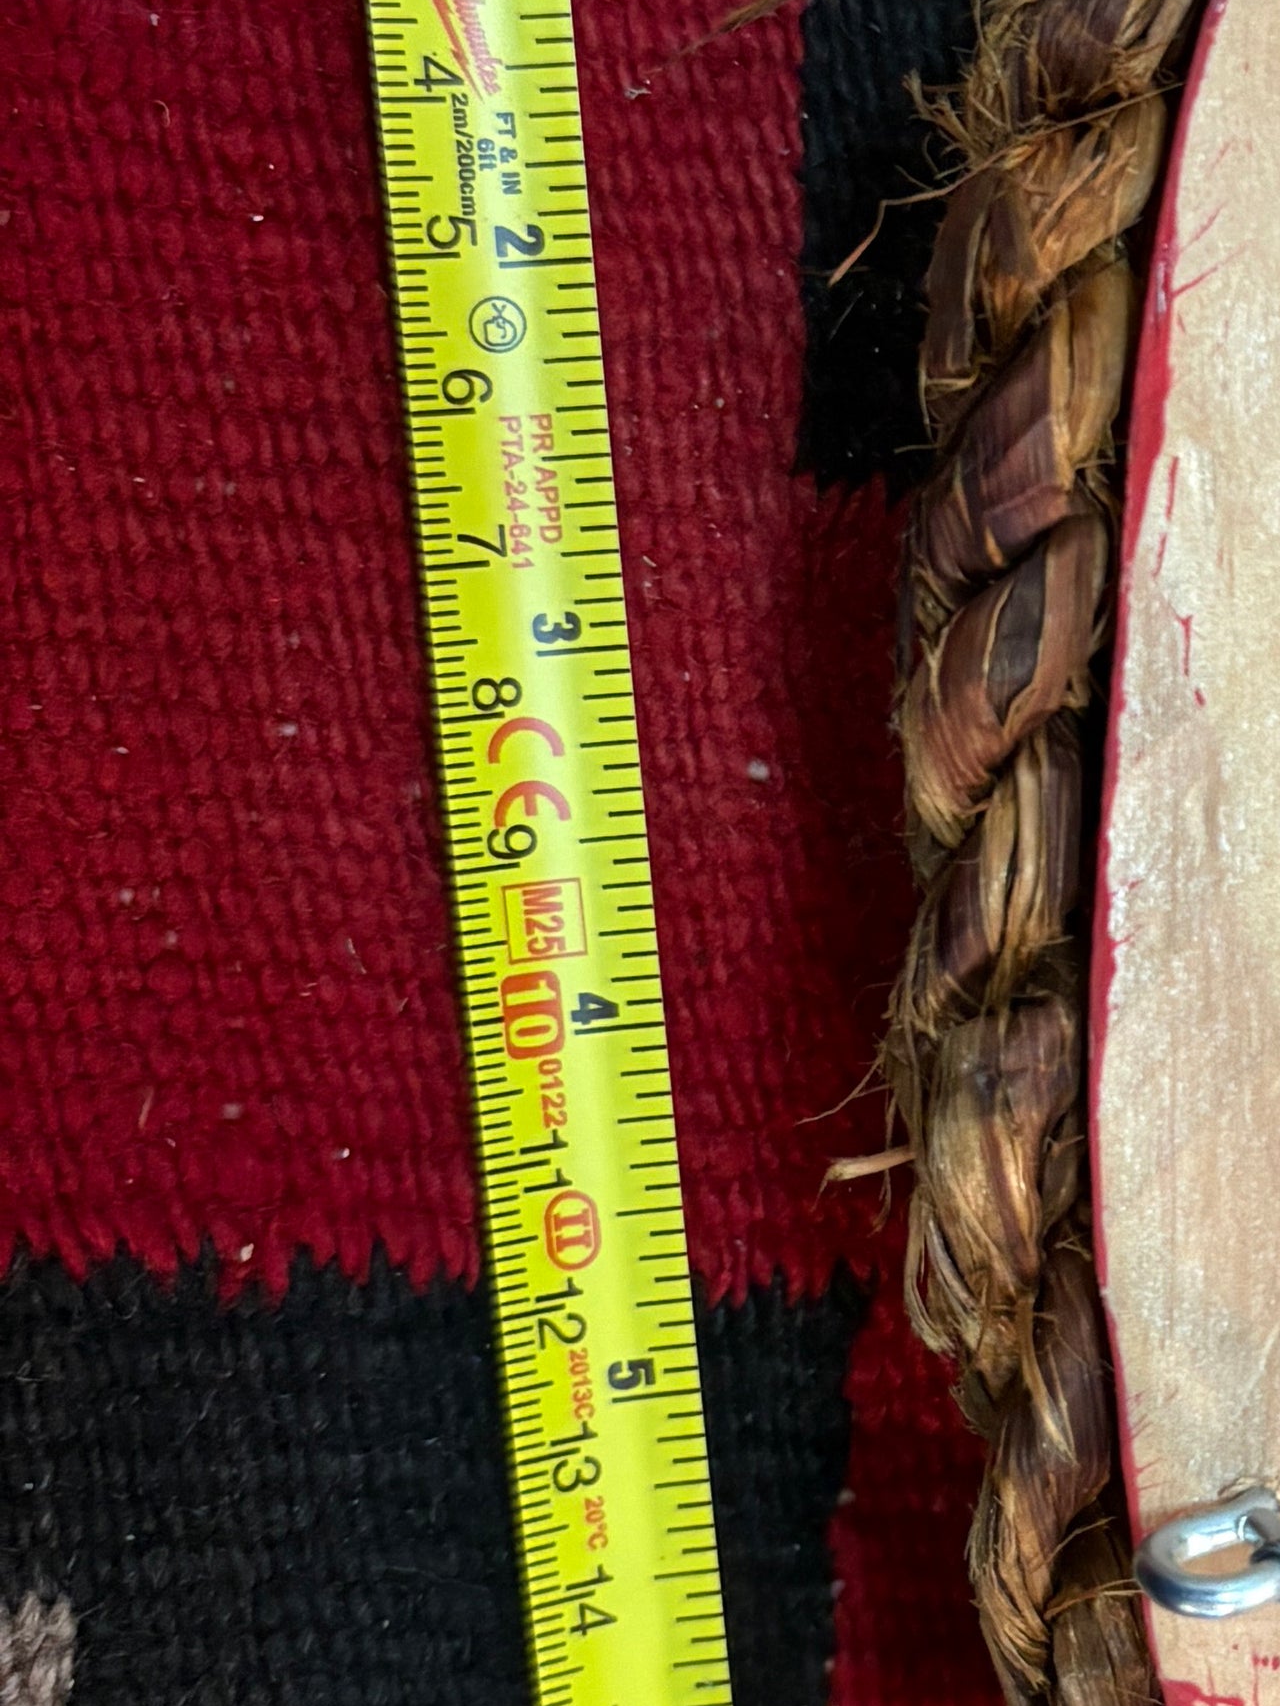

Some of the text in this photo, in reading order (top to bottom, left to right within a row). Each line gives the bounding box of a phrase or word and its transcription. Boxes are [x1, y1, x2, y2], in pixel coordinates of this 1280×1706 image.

[414, 55, 464, 92] 4
[476, 137, 497, 171] 6ft
[496, 112, 522, 195] FT & IN
[426, 214, 478, 250] 5
[493, 223, 546, 258] 2
[442, 369, 493, 406] 6
[529, 413, 563, 544] PR APPD
[457, 524, 507, 557] 7
[532, 611, 582, 644] 3
[472, 677, 522, 711] 8
[487, 824, 537, 860] 9
[522, 886, 567, 957] M25
[505, 979, 559, 1049] 10
[571, 992, 620, 1025] 4
[538, 1058, 568, 1129] 0122
[520, 1129, 573, 1194] 11
[535, 1276, 587, 1350] 12
[607, 1358, 657, 1390] 5
[550, 1421, 602, 1494] 13
[565, 1564, 618, 1636] 14
